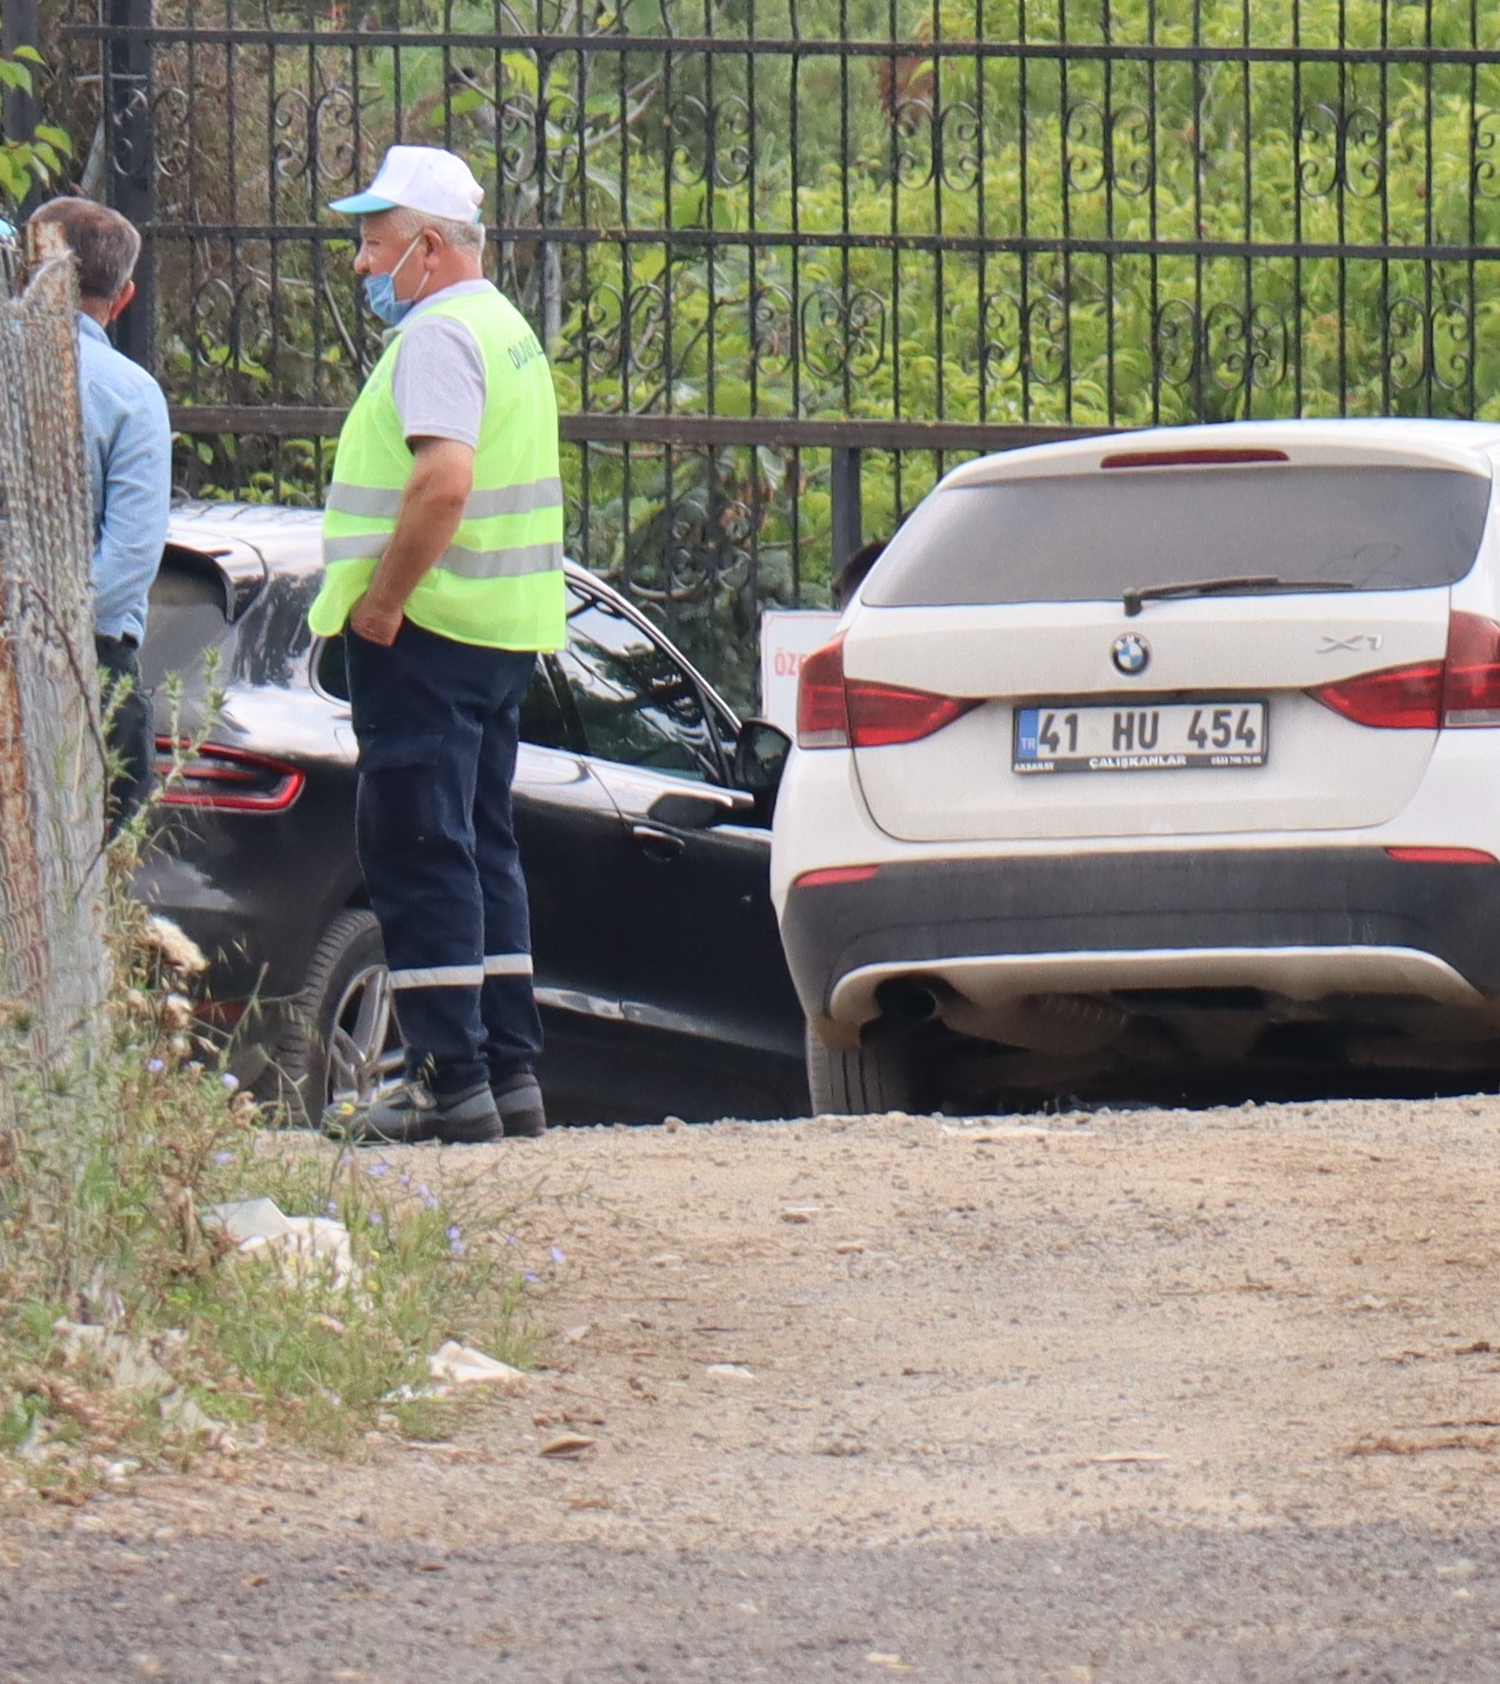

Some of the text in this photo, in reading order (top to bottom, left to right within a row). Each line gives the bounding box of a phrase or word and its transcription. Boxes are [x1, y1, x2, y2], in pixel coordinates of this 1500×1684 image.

[1315, 632, 1383, 653] X1
[1039, 708, 1256, 753] 41 HU 454
[1020, 737, 1036, 751] TR
